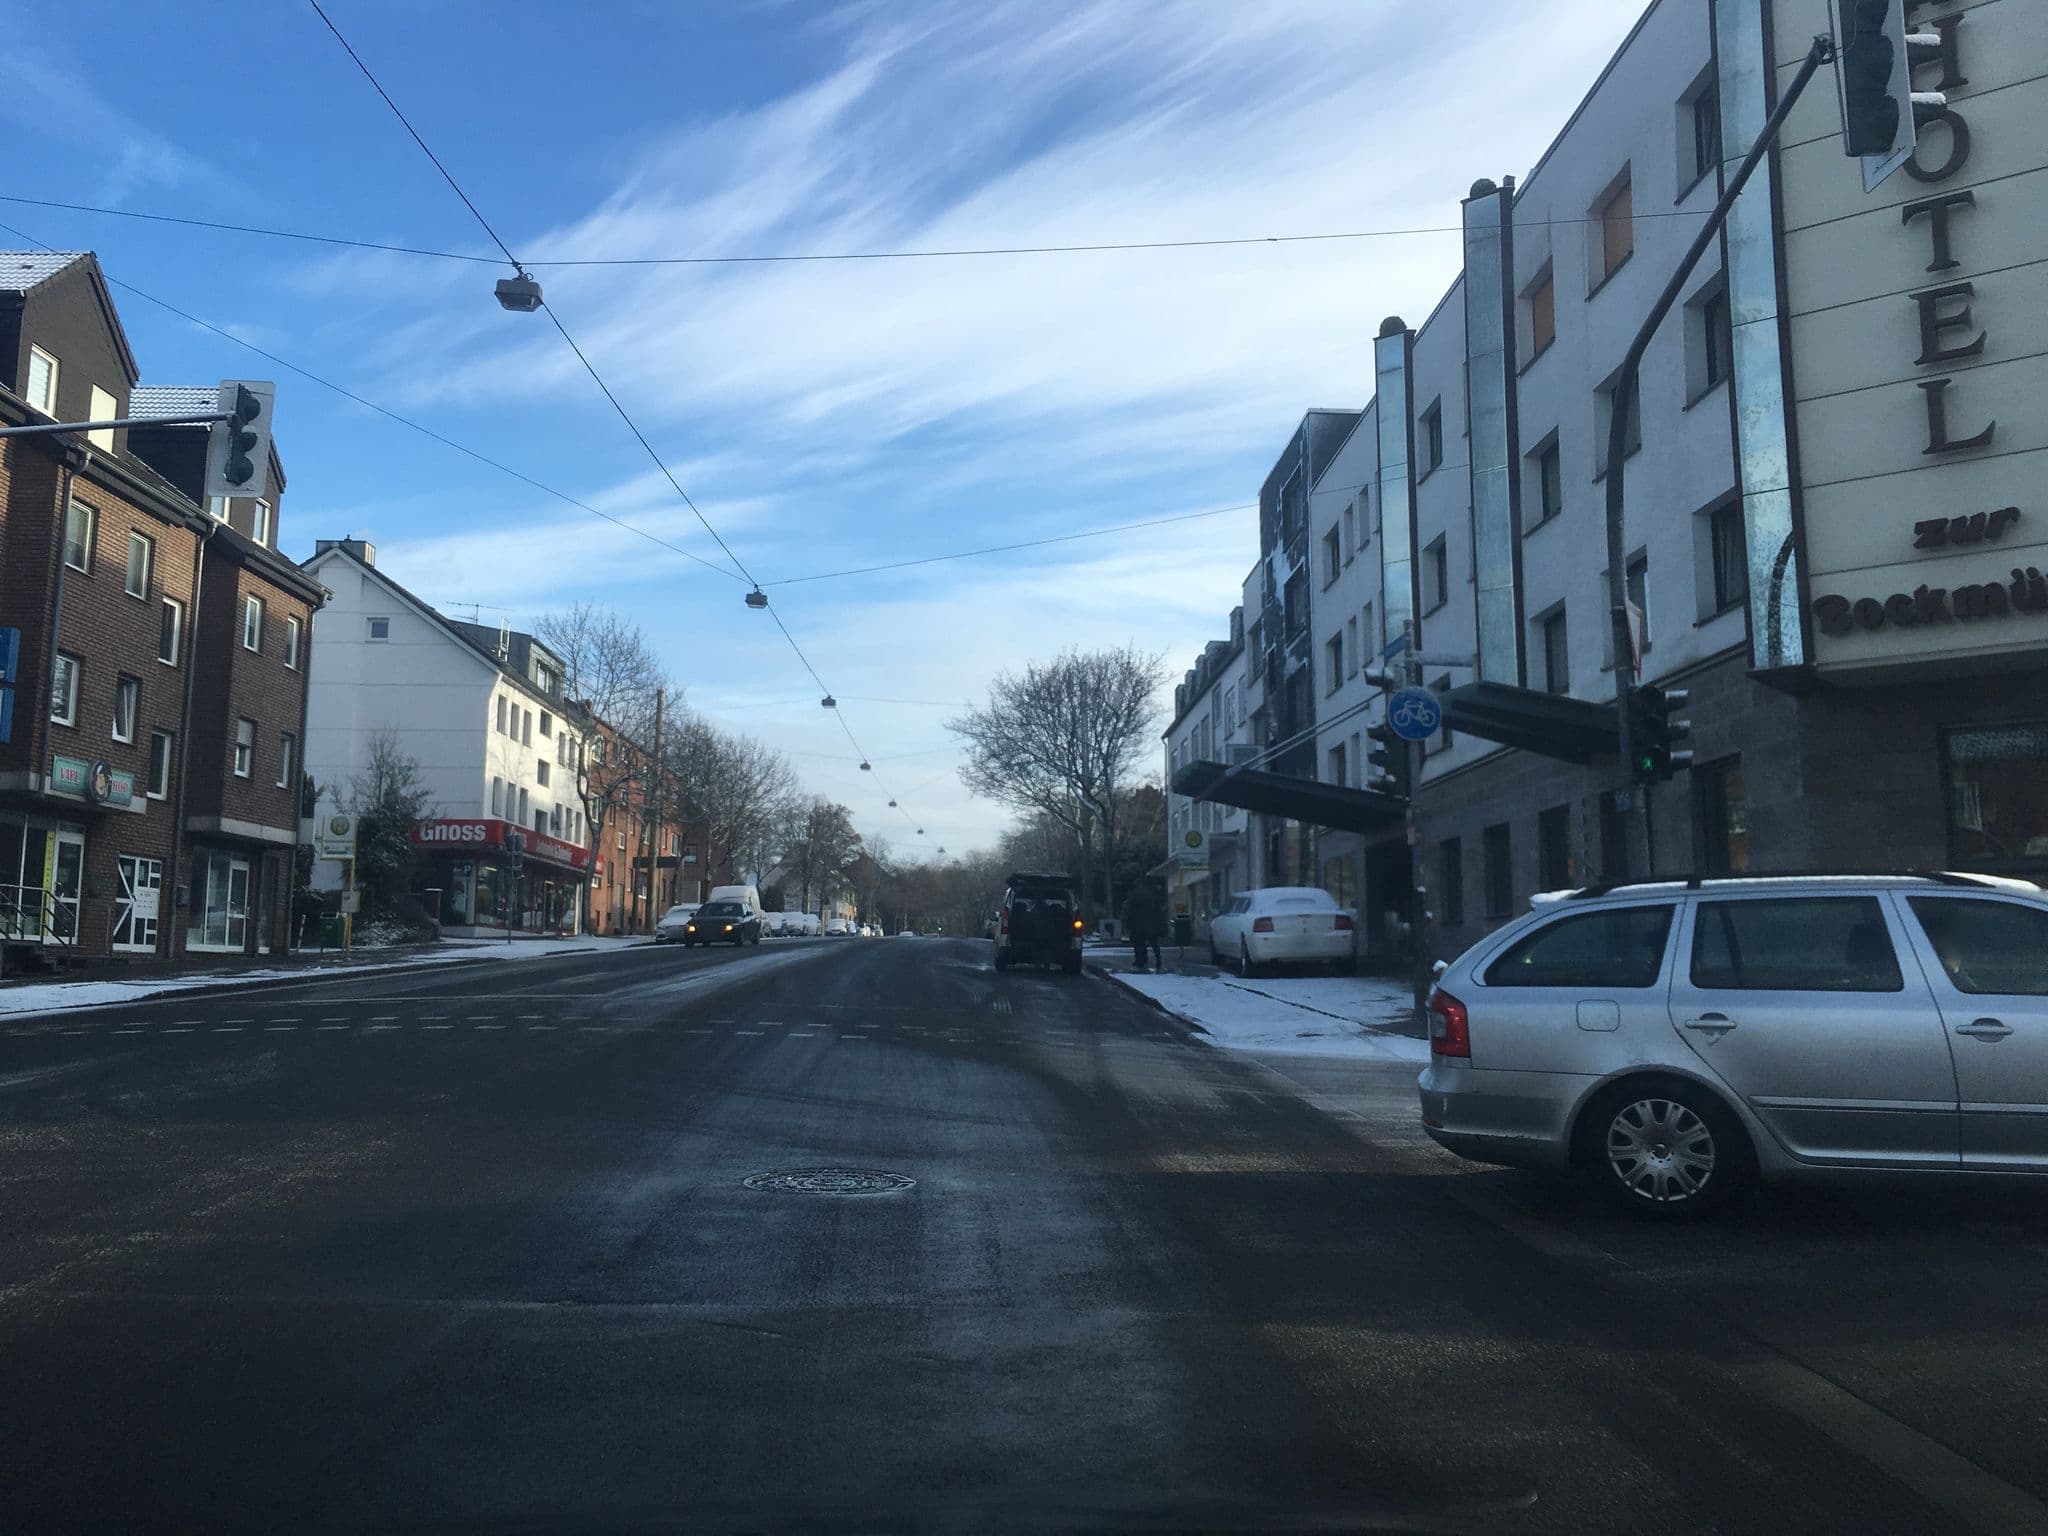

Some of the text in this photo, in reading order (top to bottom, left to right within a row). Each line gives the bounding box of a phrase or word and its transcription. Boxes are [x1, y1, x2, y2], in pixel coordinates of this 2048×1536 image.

[1913, 506, 2021, 549] zur
[1812, 566, 2048, 636] Bockmü
[421, 822, 486, 841] Gnoss
